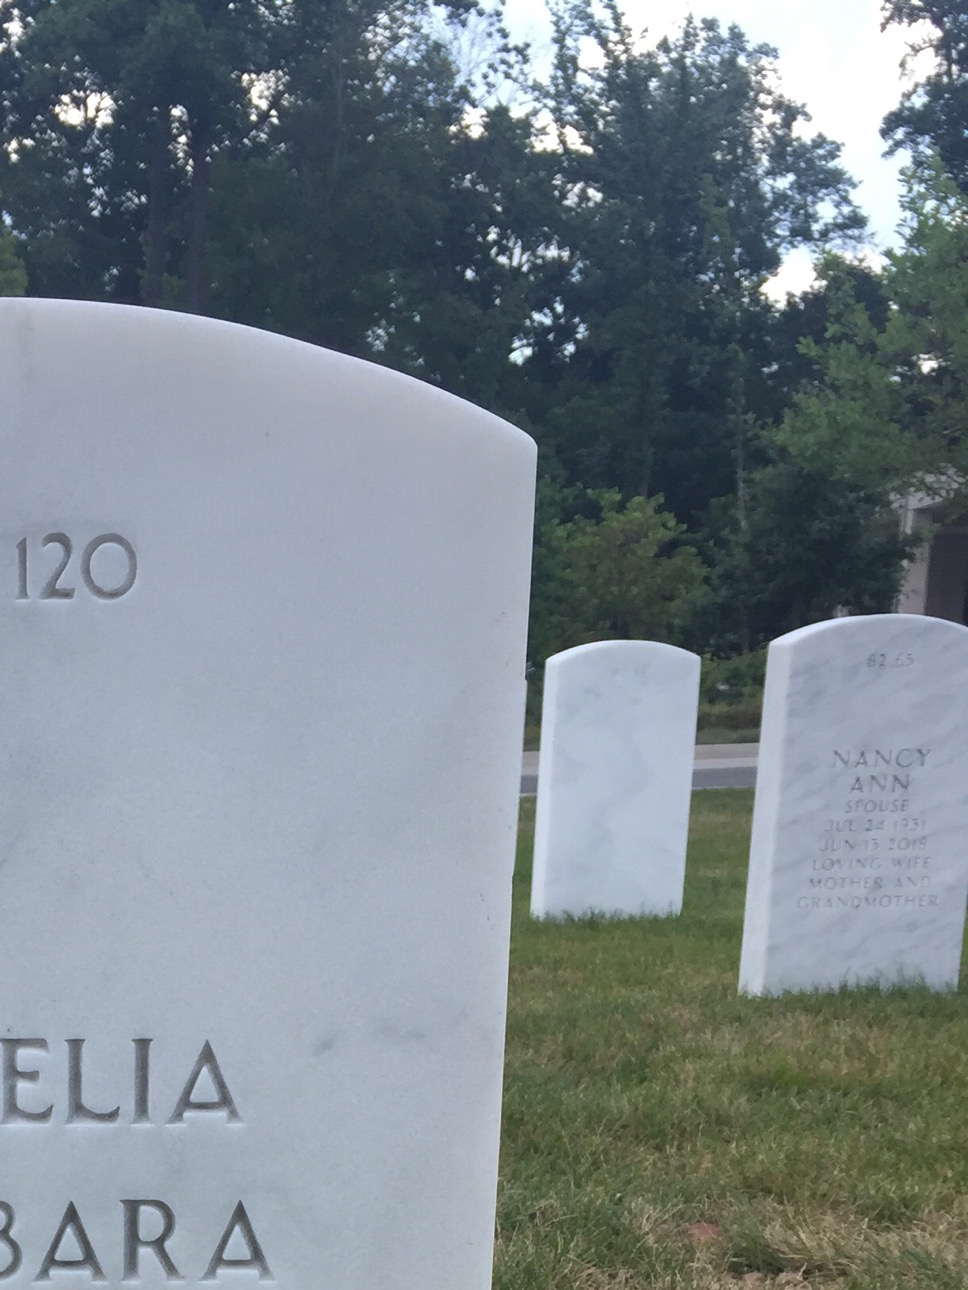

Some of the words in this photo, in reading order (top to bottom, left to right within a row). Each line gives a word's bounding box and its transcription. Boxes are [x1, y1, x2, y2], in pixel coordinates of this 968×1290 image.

[15, 532, 138, 600] 120
[833, 748, 932, 768] NANCY
[850, 774, 912, 793] ANN
[844, 799, 910, 813] SPOUSE
[819, 838, 856, 852] JUN
[812, 856, 882, 870] LOVING
[891, 856, 932, 869] WIFE
[808, 876, 884, 890] MOTHER
[893, 875, 932, 889] AND
[796, 894, 940, 909] GRANDMOTHER
